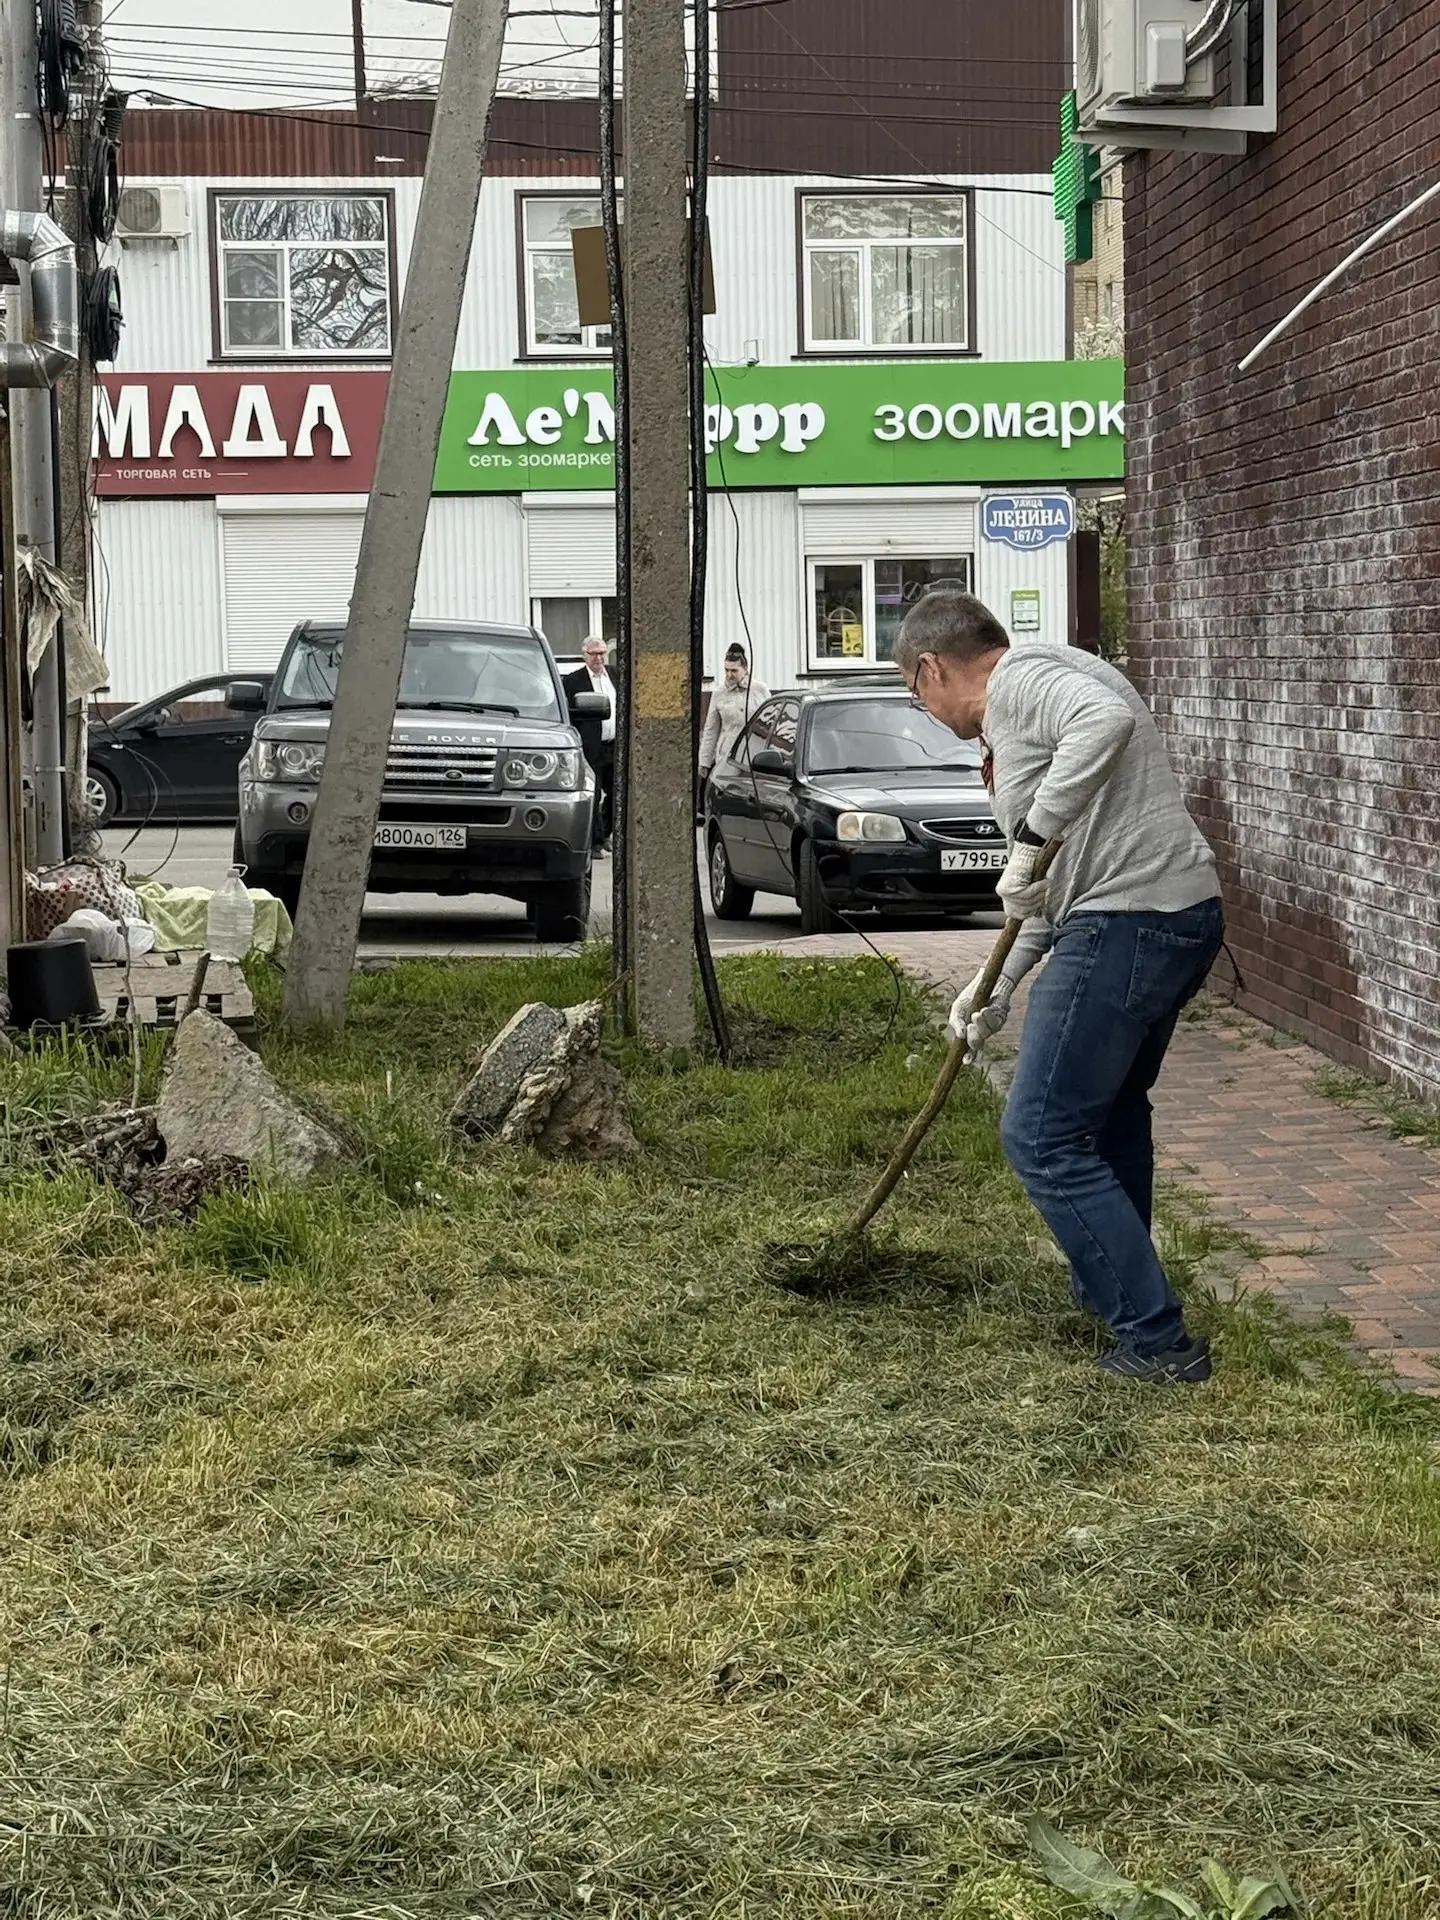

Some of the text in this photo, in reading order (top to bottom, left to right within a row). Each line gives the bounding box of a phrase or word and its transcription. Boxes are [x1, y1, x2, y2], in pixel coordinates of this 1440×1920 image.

[468, 452, 616, 469] сеть зоомарке
[116, 469, 212, 480] ТОРГОВАЯ СЕТЬ
[990, 509, 1067, 527] ЛЕНИНА
[1013, 529, 1043, 542] 167/3
[427, 735, 496, 744] ROVER
[438, 829, 461, 842] 126
